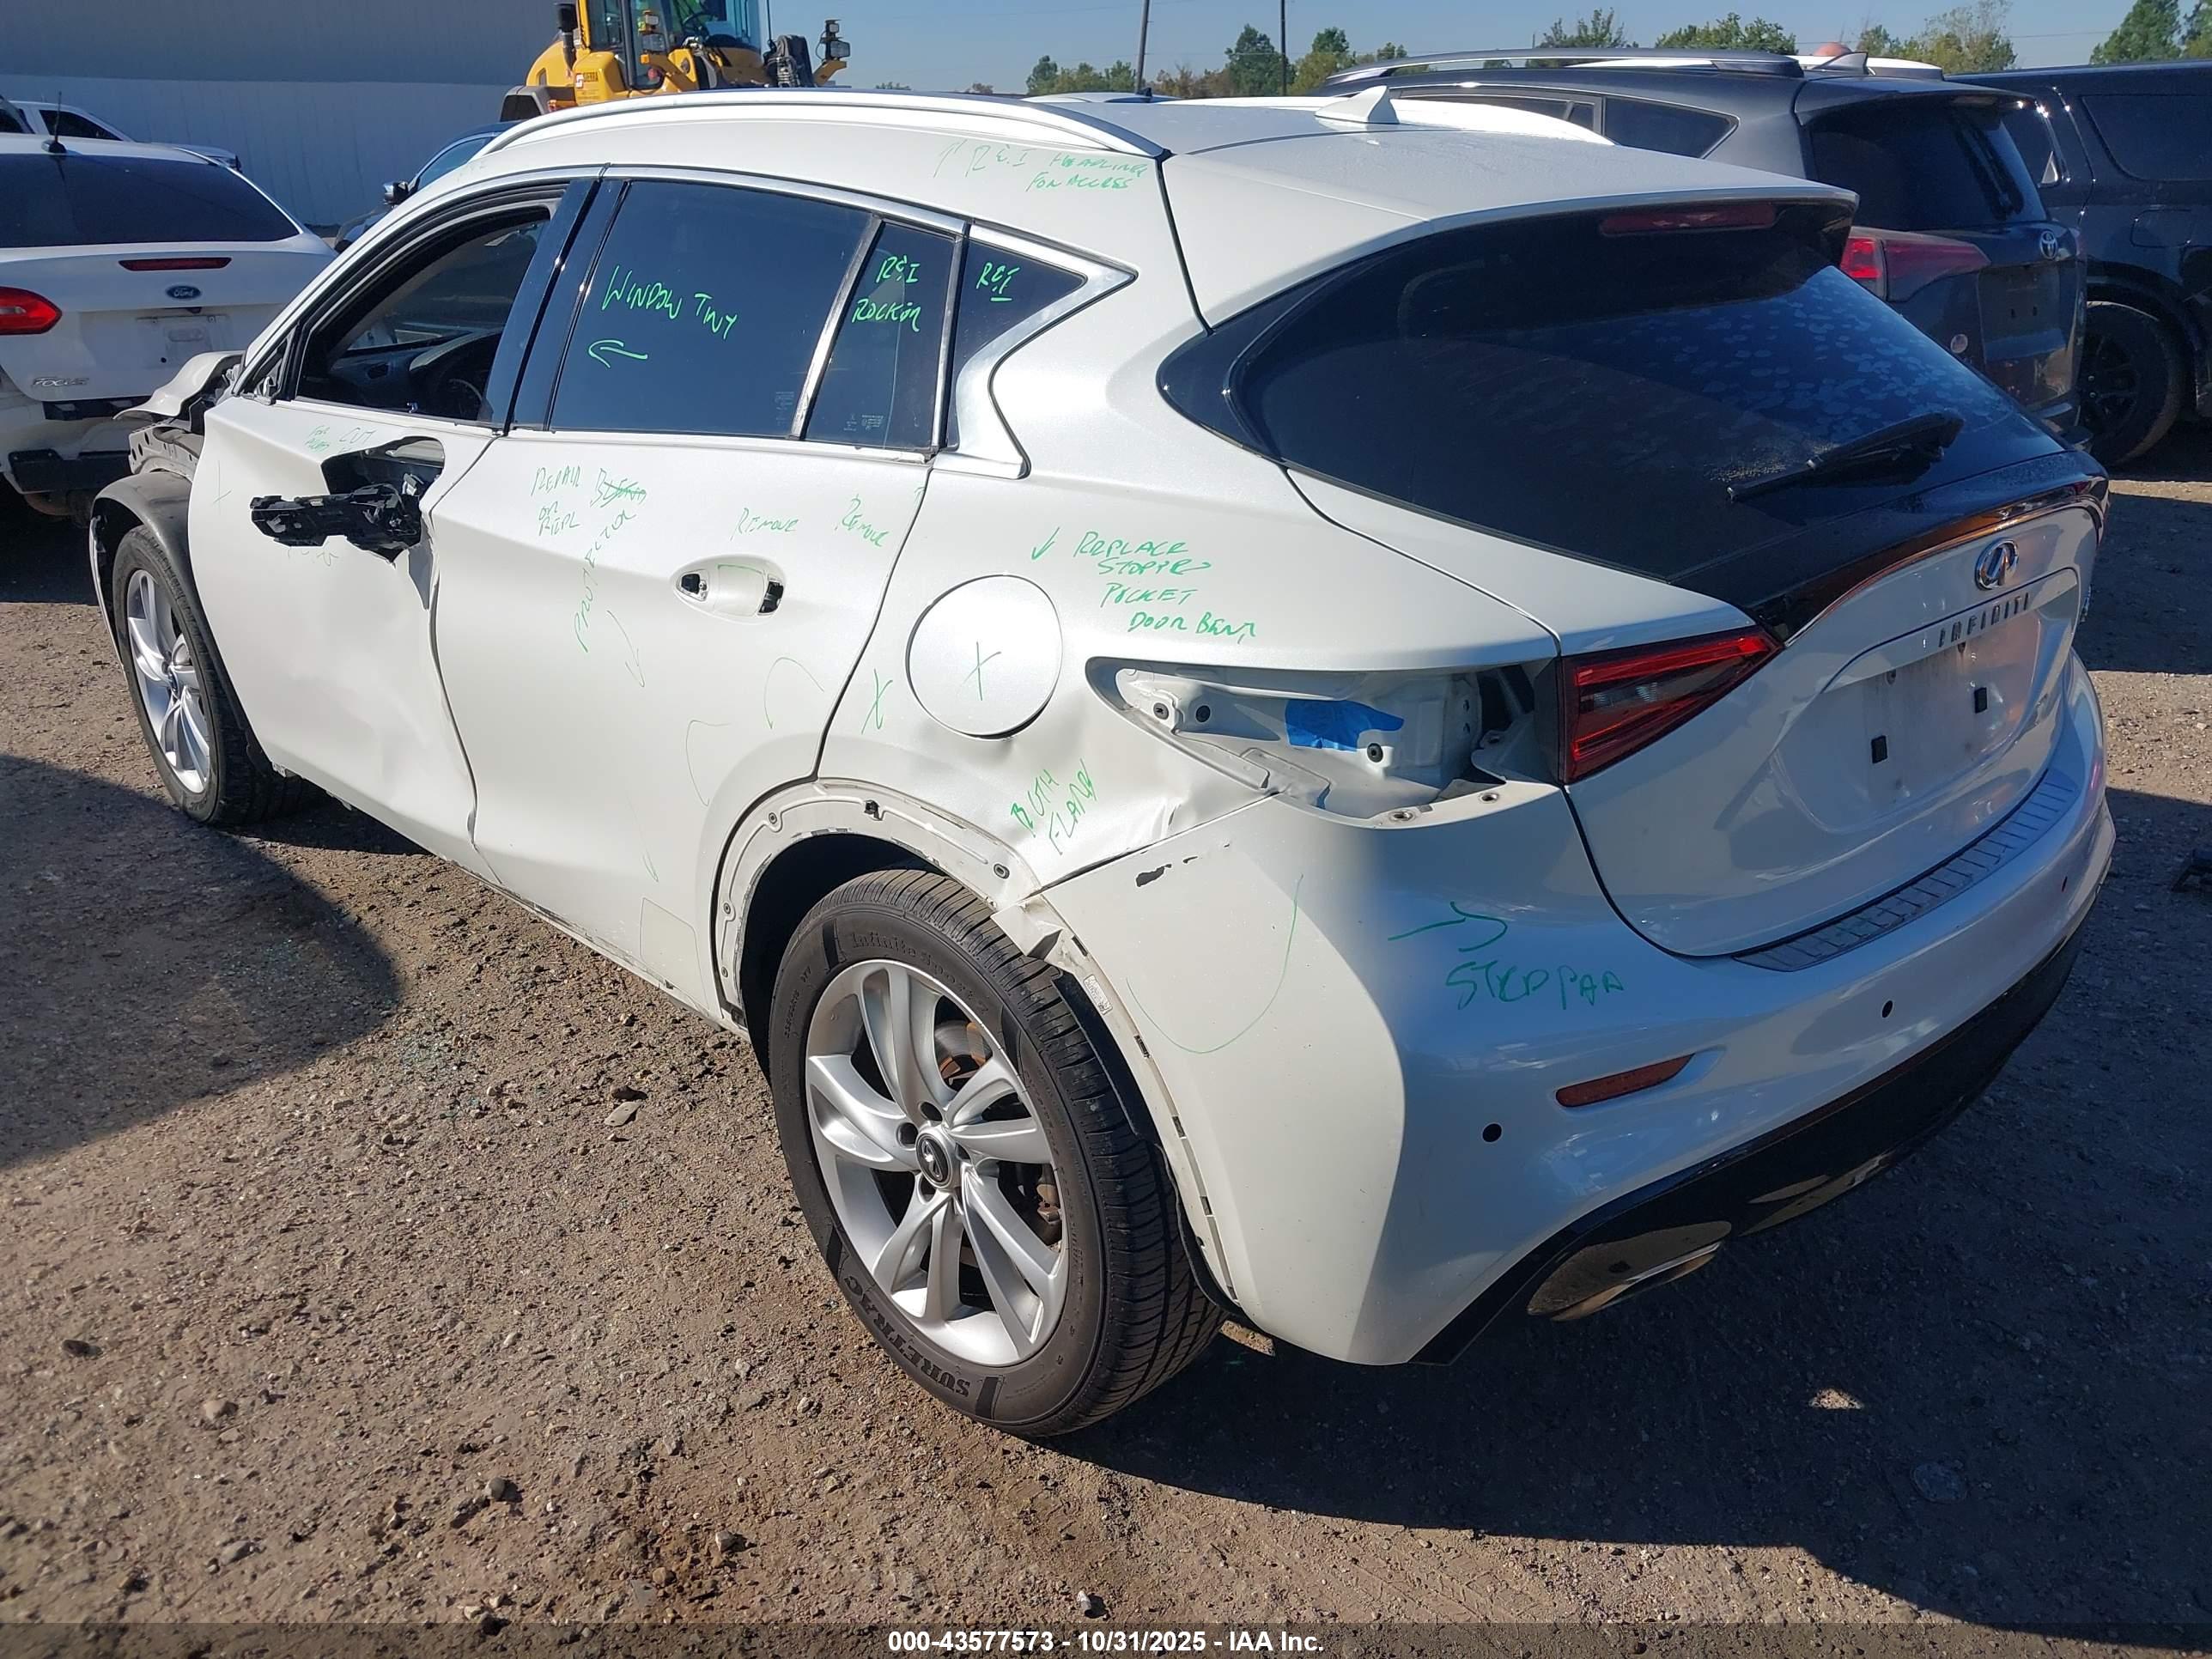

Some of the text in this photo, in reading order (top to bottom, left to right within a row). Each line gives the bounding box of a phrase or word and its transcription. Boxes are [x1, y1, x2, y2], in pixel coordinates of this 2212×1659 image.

[602, 265, 682, 319] WINDOW
[1938, 592, 2030, 647] INFINITI
[844, 1276, 970, 1398] SURETRAC
